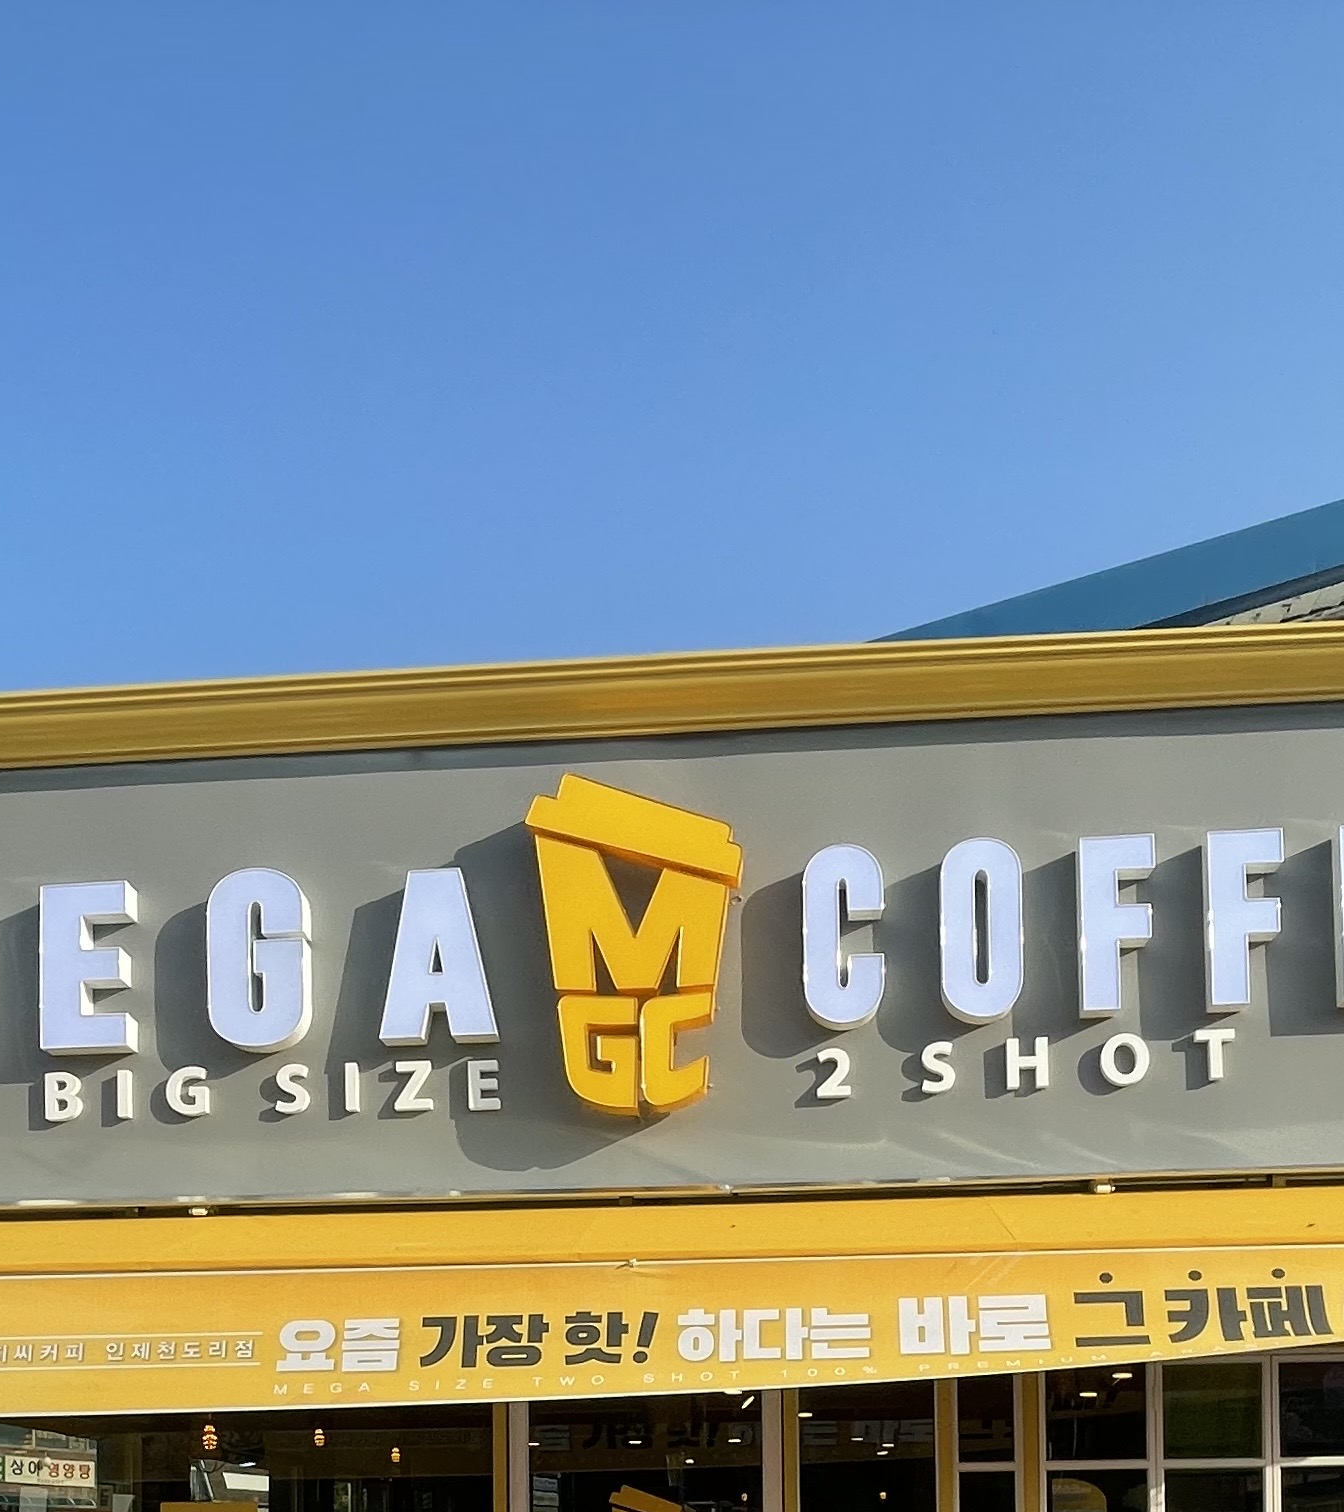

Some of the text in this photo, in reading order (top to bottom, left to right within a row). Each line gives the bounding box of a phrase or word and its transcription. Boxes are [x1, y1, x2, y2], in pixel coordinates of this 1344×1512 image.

[43, 1059, 504, 1124] BIG SIZE
[815, 1028, 1237, 1101] 2 SHOT
[105, 1339, 256, 1362] 인제천도리점
[276, 1317, 401, 1373] 요즘
[419, 1313, 551, 1368] 가장
[564, 1310, 660, 1365] 핫!
[676, 1305, 872, 1361] 하다는
[898, 1293, 1053, 1356] 바로
[273, 1381, 372, 1395] MEGA
[409, 1377, 494, 1392] SIZE
[532, 1373, 606, 1388] TWO
[643, 1368, 742, 1383] SHOT
[781, 1364, 879, 1379] 100%
